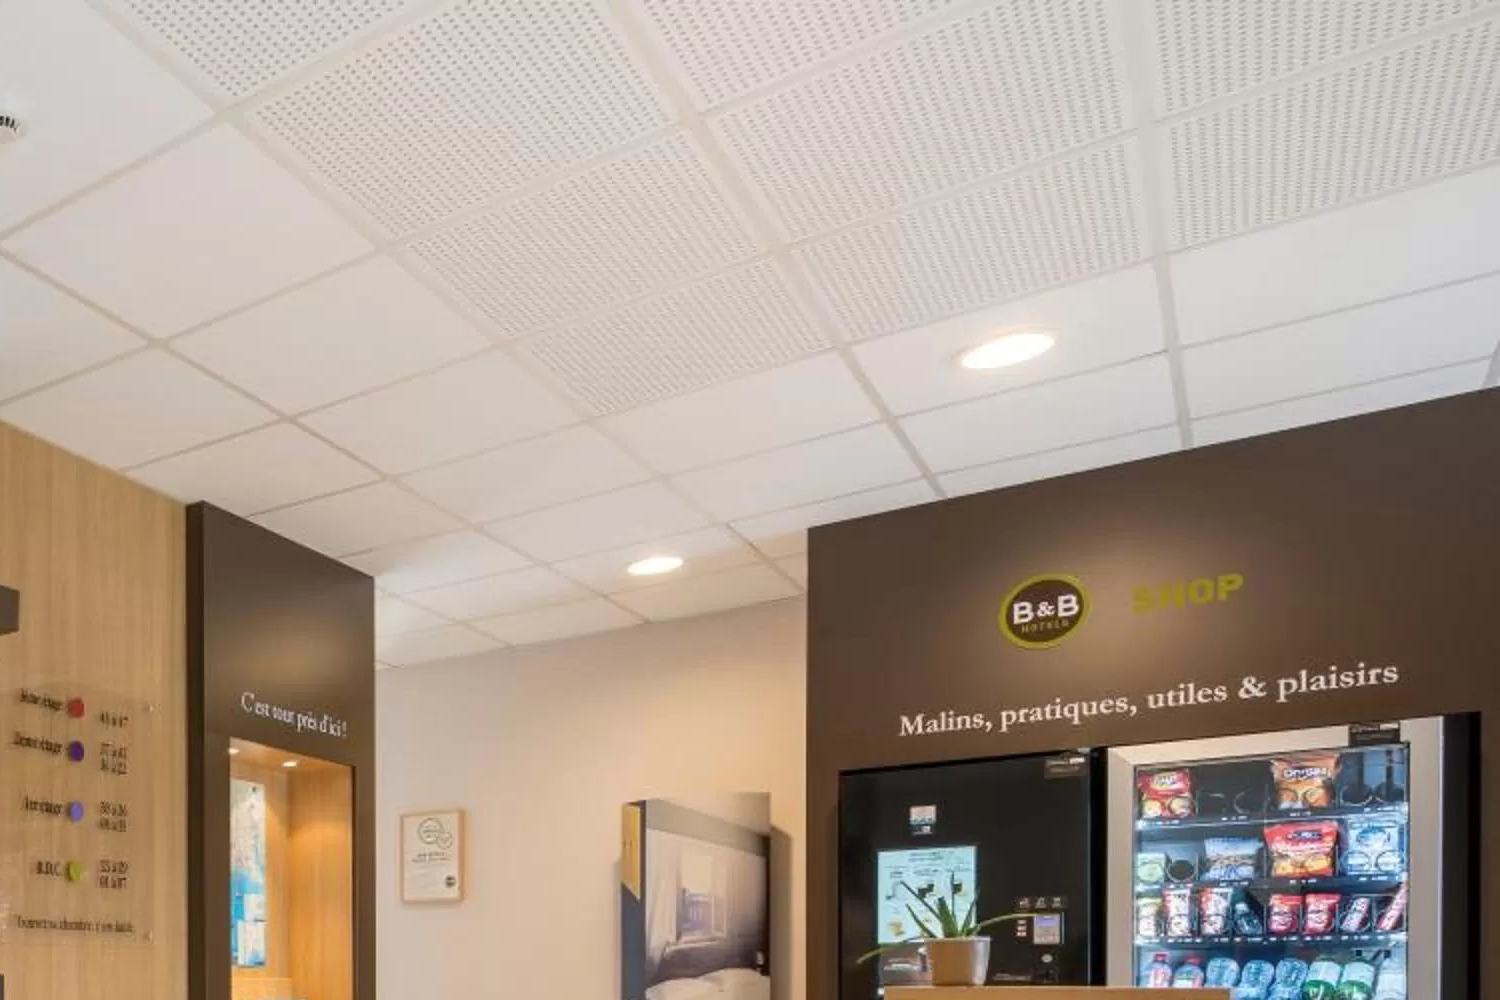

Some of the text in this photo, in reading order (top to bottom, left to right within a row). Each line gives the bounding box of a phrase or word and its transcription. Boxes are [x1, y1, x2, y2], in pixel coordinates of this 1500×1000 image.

[1012, 574, 1244, 625] B&B SHOP
[899, 661, 1399, 737] Malins, pratiques, utiles & plaisirs
